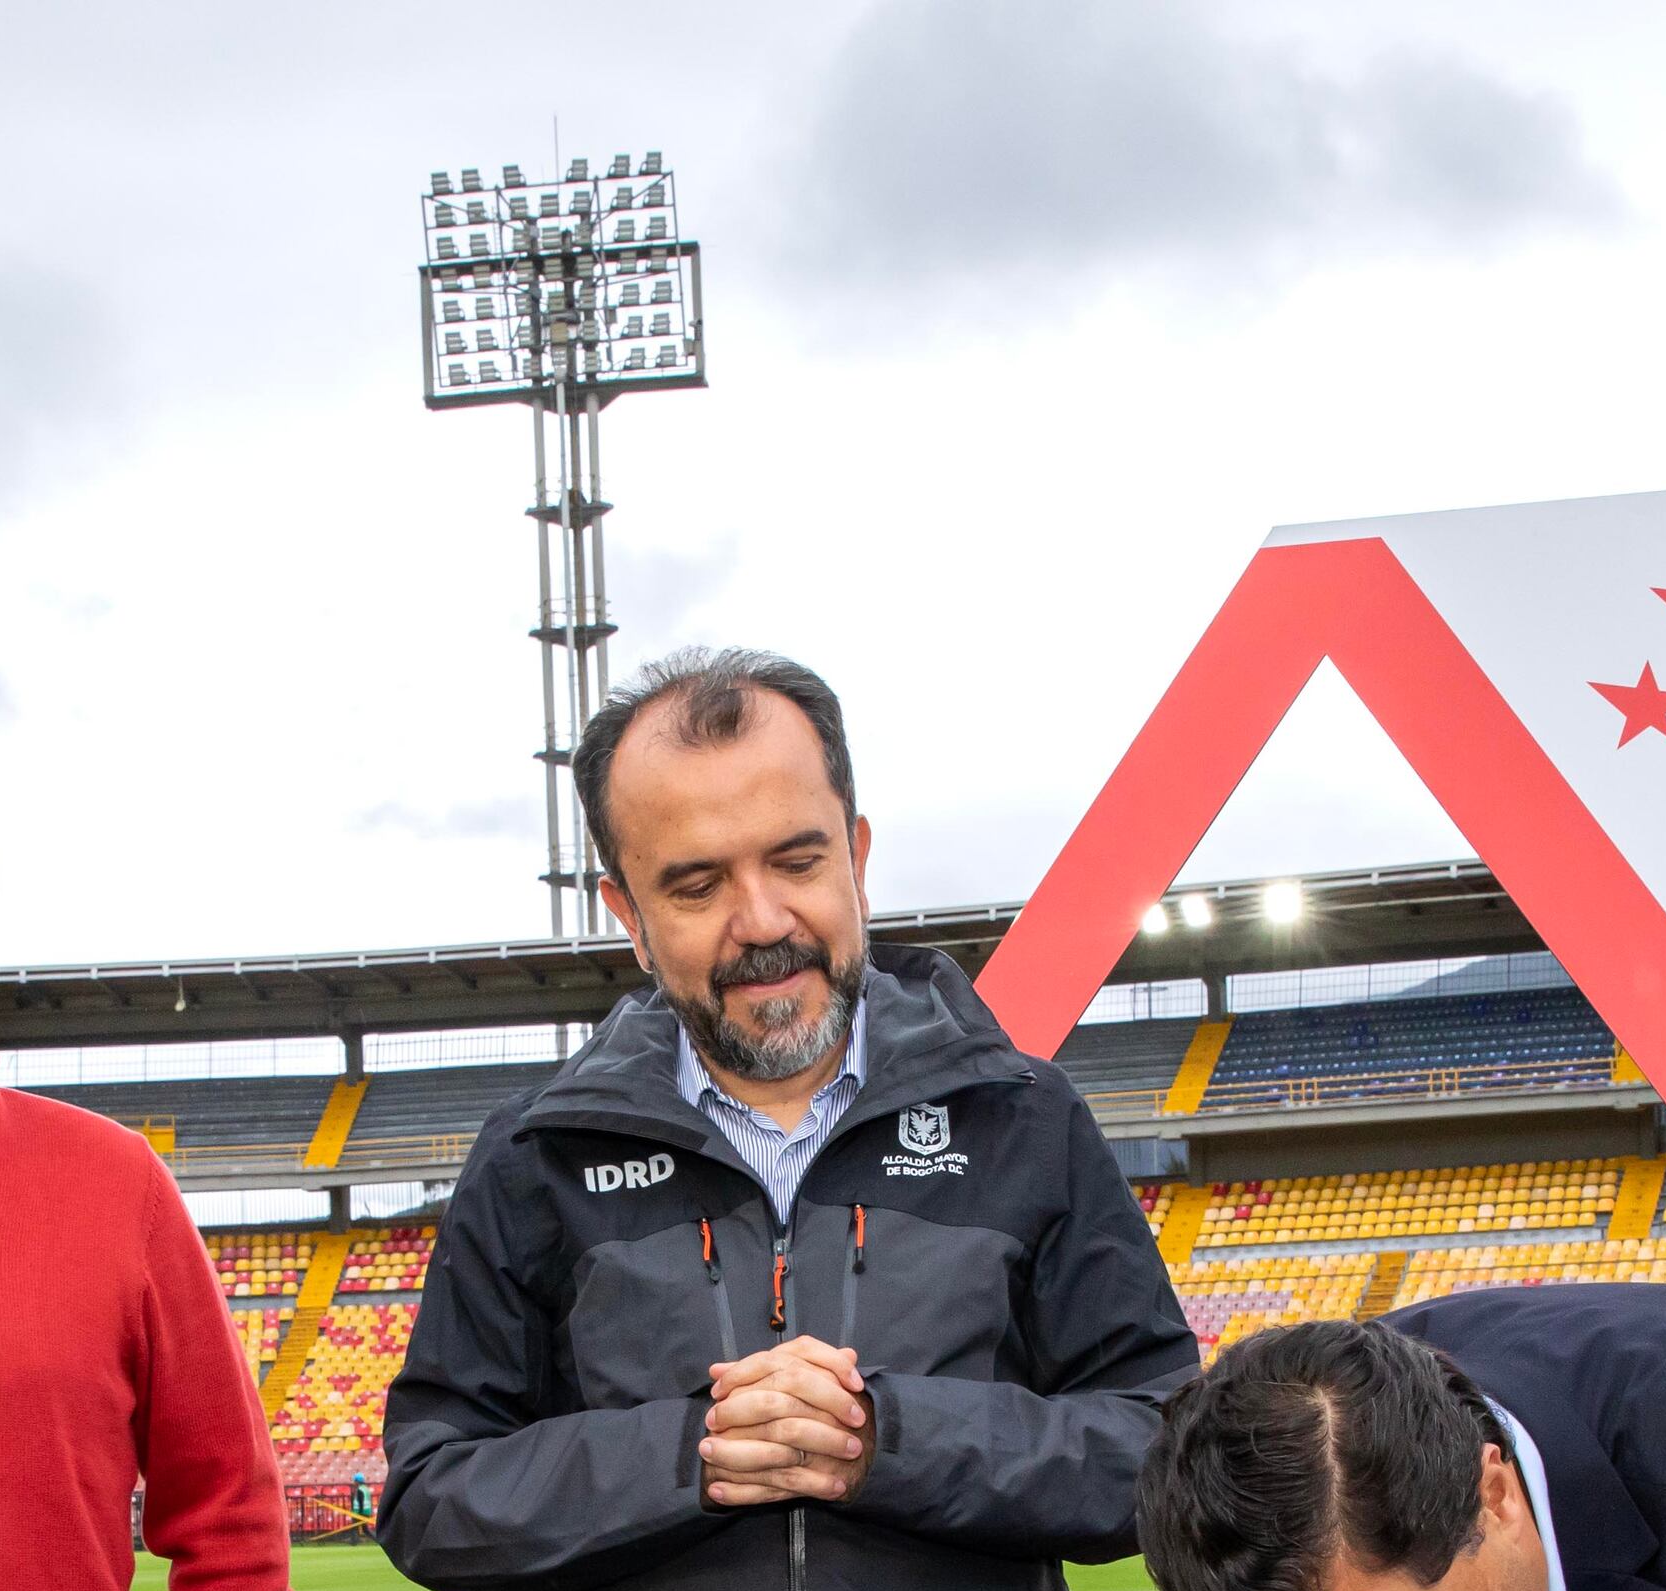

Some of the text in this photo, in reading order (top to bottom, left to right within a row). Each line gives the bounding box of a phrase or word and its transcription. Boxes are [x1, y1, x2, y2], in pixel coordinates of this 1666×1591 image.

[882, 1153, 968, 1167] ALCALDÍA MAYOR
[584, 1153, 675, 1193] IDRD
[886, 1163, 964, 1176] DE BOGOTÁ D.C.
